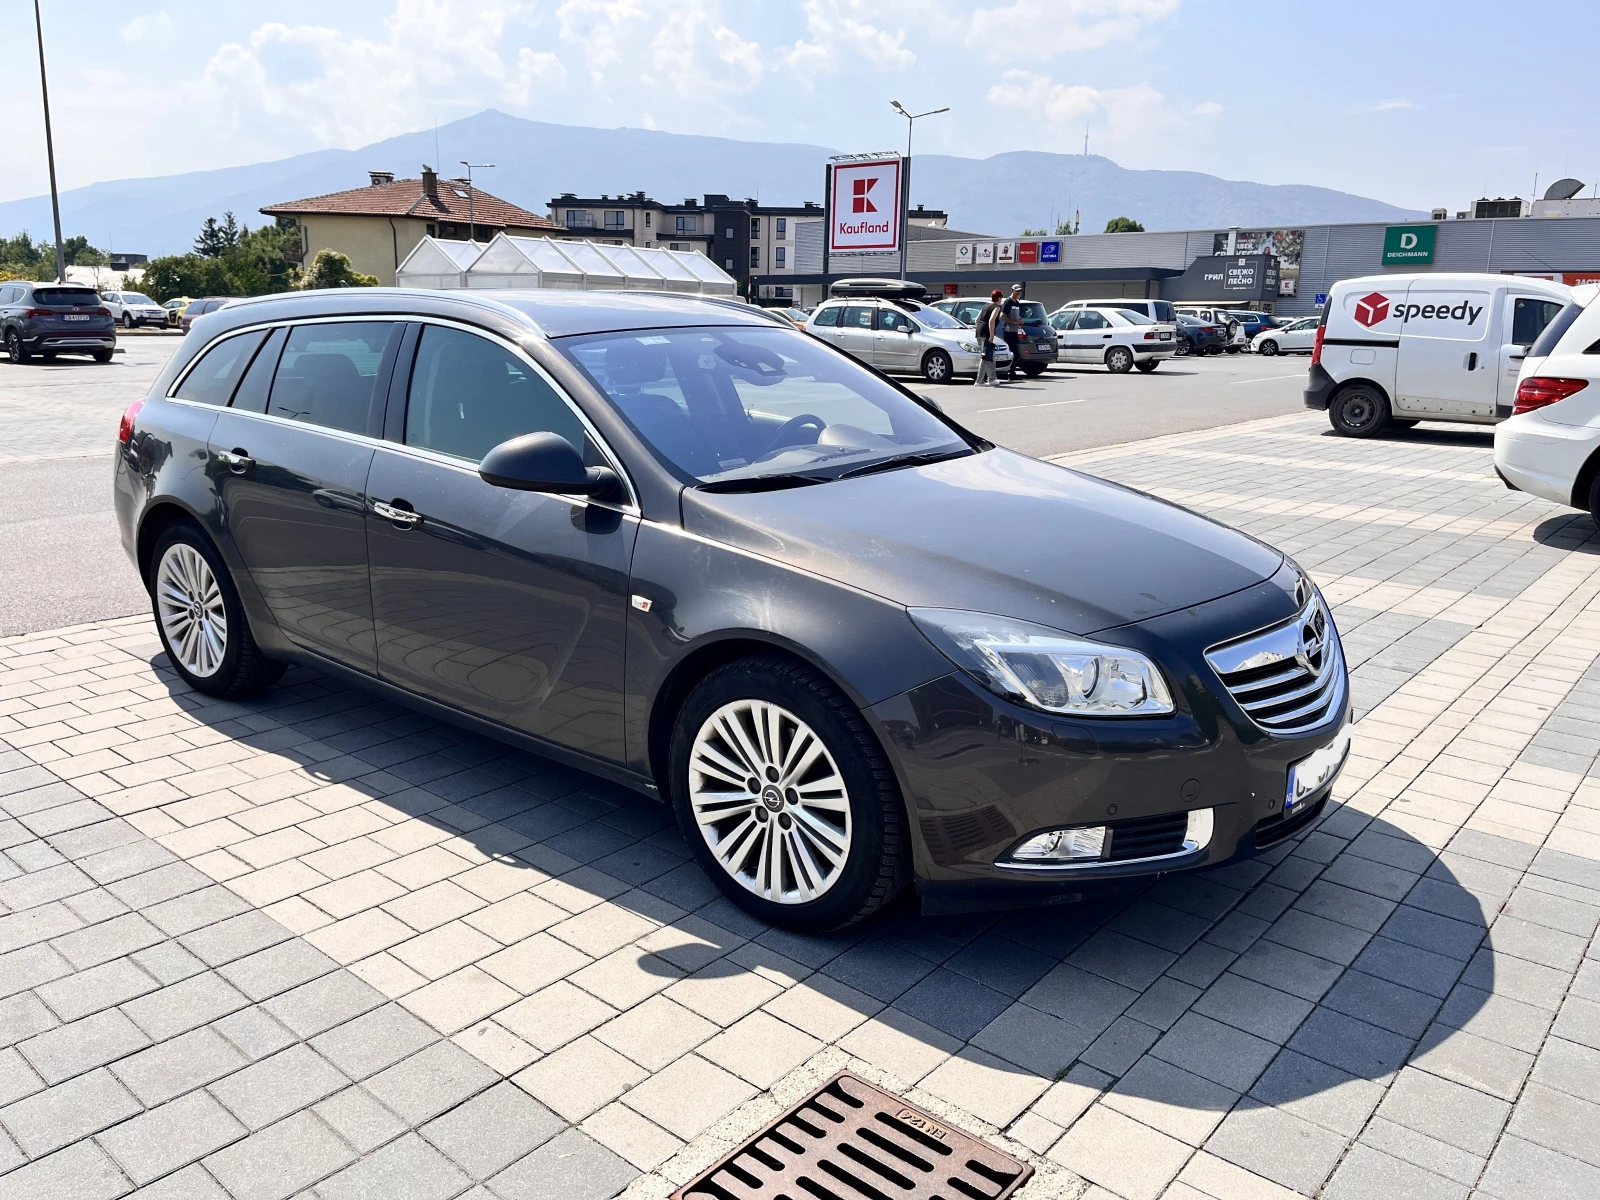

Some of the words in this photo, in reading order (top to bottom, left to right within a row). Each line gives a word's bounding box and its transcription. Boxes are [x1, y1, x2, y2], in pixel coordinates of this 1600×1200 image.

[840, 221, 889, 234] Kaufland
[1400, 233, 1418, 249] D
[1393, 300, 1483, 325] speedy
[900, 1111, 926, 1128] 124
[926, 1124, 948, 1140] EN
